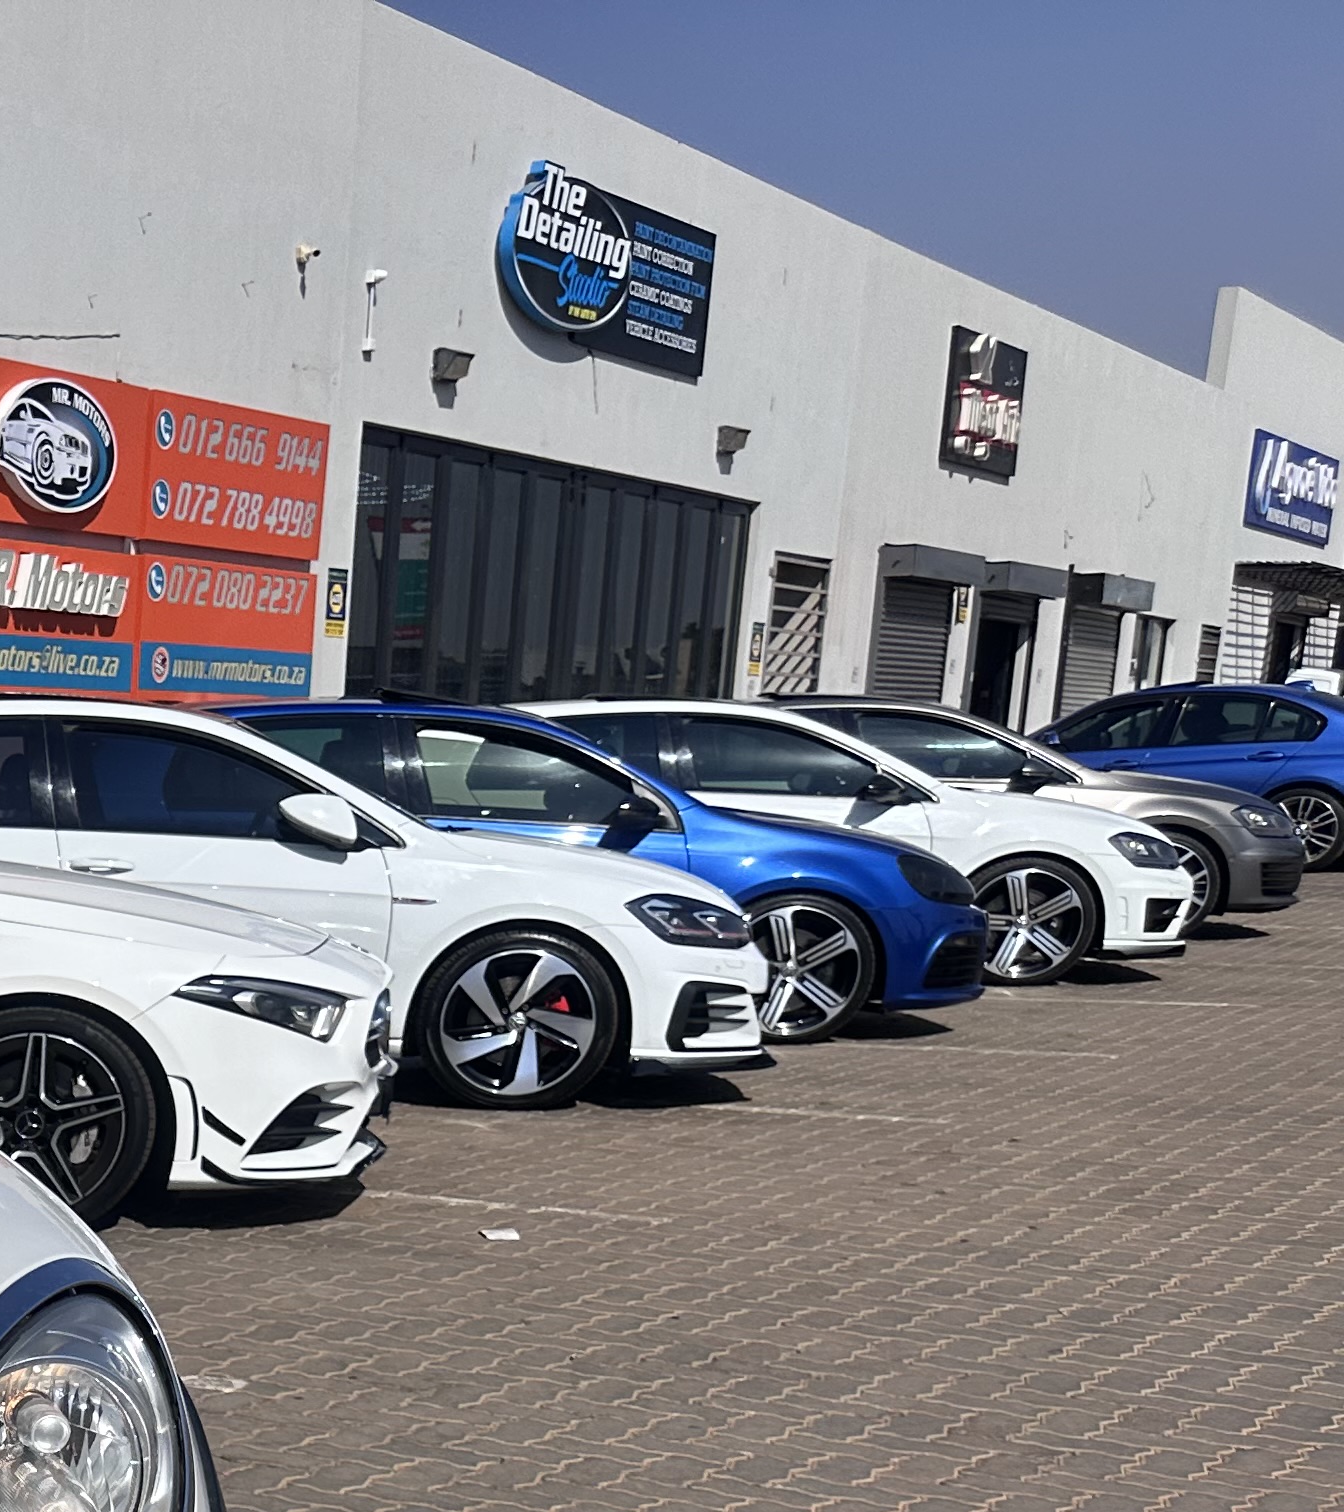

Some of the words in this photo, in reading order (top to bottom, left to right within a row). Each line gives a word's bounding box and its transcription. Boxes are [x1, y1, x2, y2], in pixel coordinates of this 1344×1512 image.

[542, 162, 587, 218] The
[516, 195, 632, 280] Detailing
[51, 386, 72, 406] MR.
[72, 392, 112, 448] MOTORS
[178, 412, 225, 460] 012
[224, 422, 269, 466] 666
[274, 431, 324, 477] 9144
[173, 480, 220, 526] 072
[220, 488, 264, 532] 788
[263, 496, 317, 539] 4998
[13, 552, 129, 617] Motors
[166, 563, 213, 606] 072
[212, 568, 256, 610] 080
[255, 573, 310, 616] 2237
[171, 657, 307, 686] www.mrmotors.co.za
